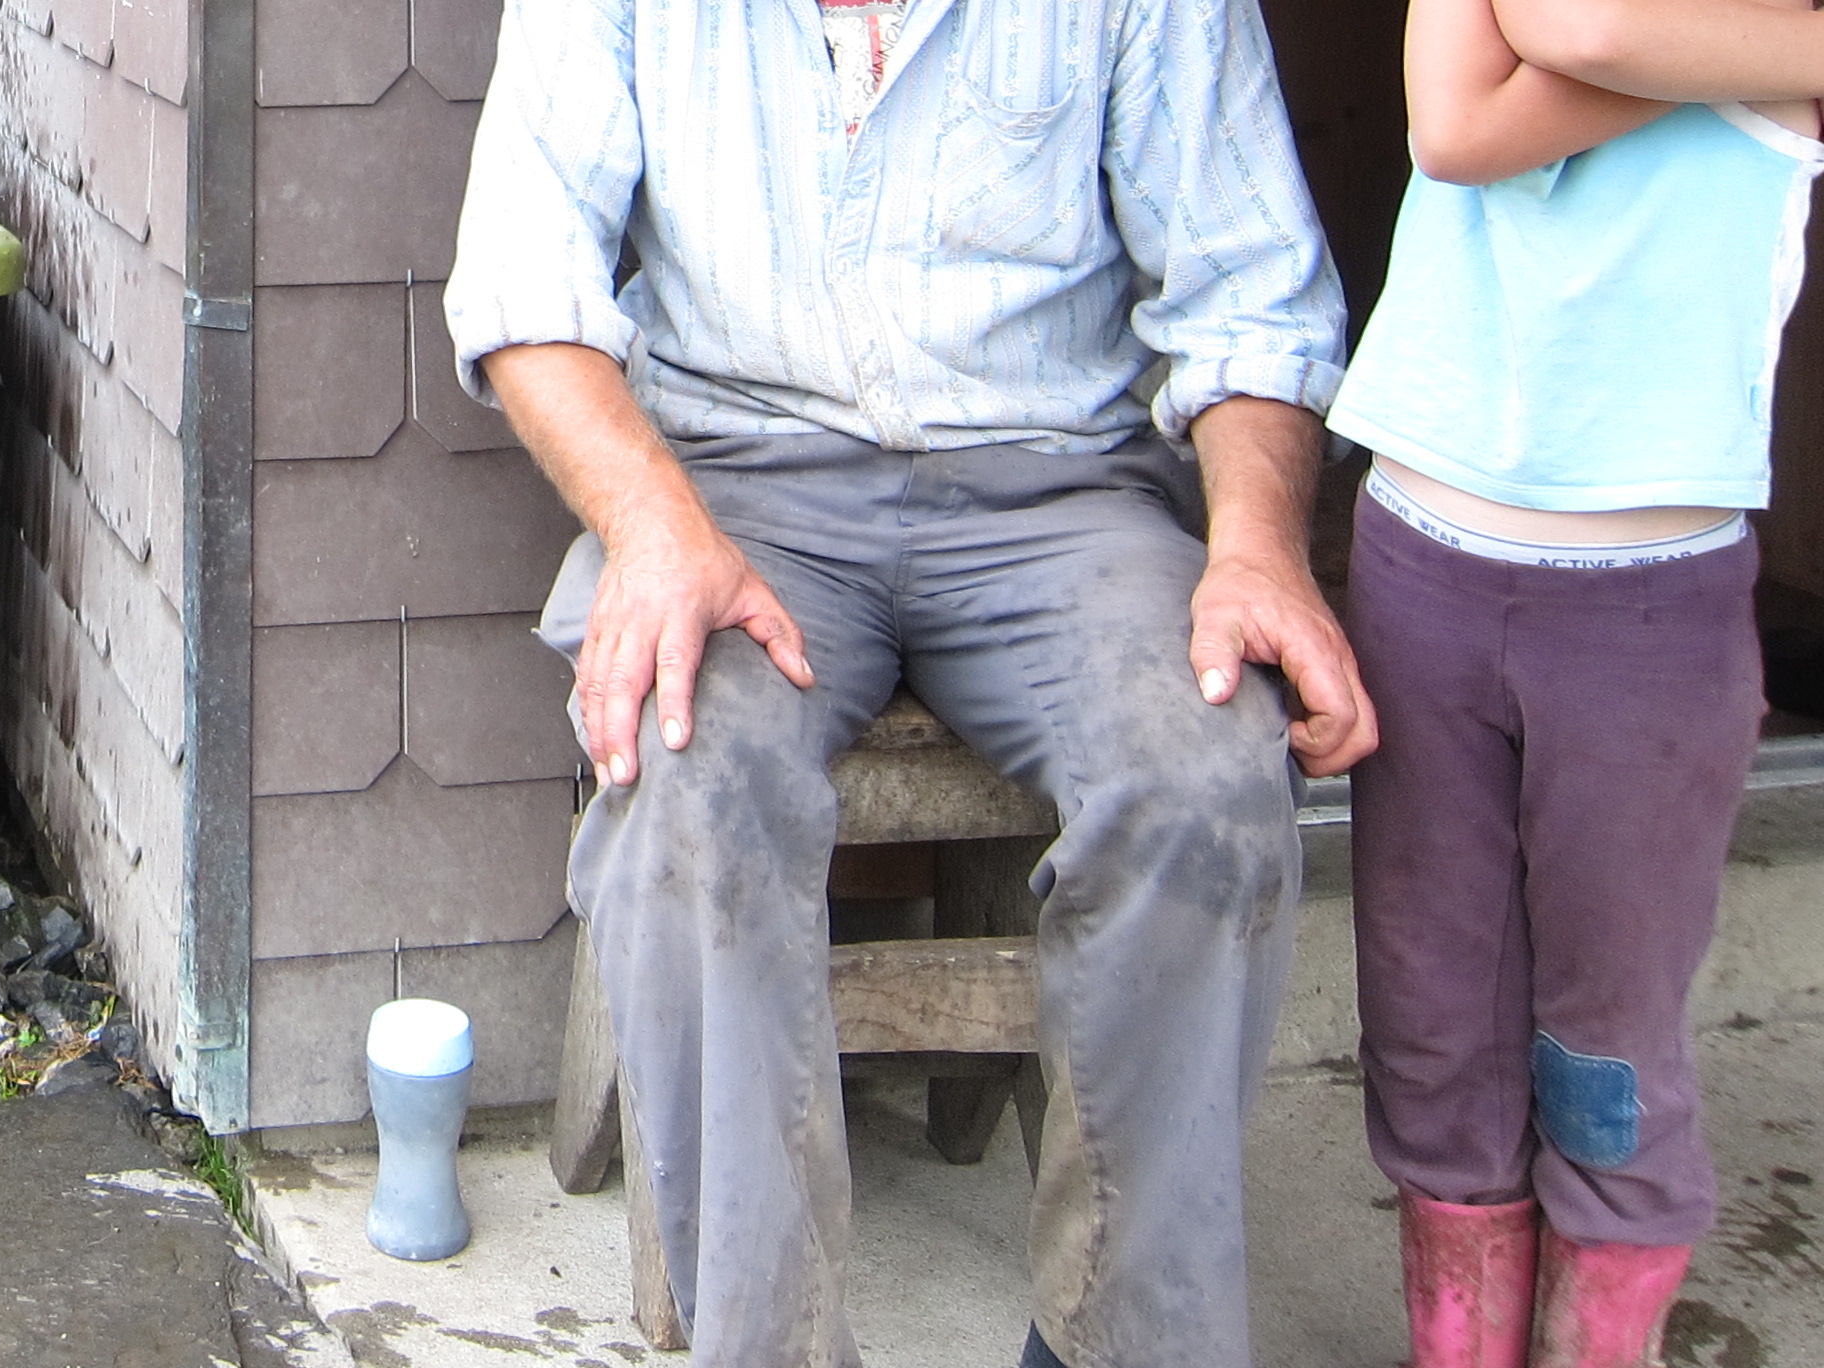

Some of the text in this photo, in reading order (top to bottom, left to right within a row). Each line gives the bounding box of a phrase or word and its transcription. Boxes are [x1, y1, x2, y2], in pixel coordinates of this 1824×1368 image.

[1371, 482, 1462, 550] ACTIVE WEAR
[1537, 558, 1616, 569] ACTIVE
